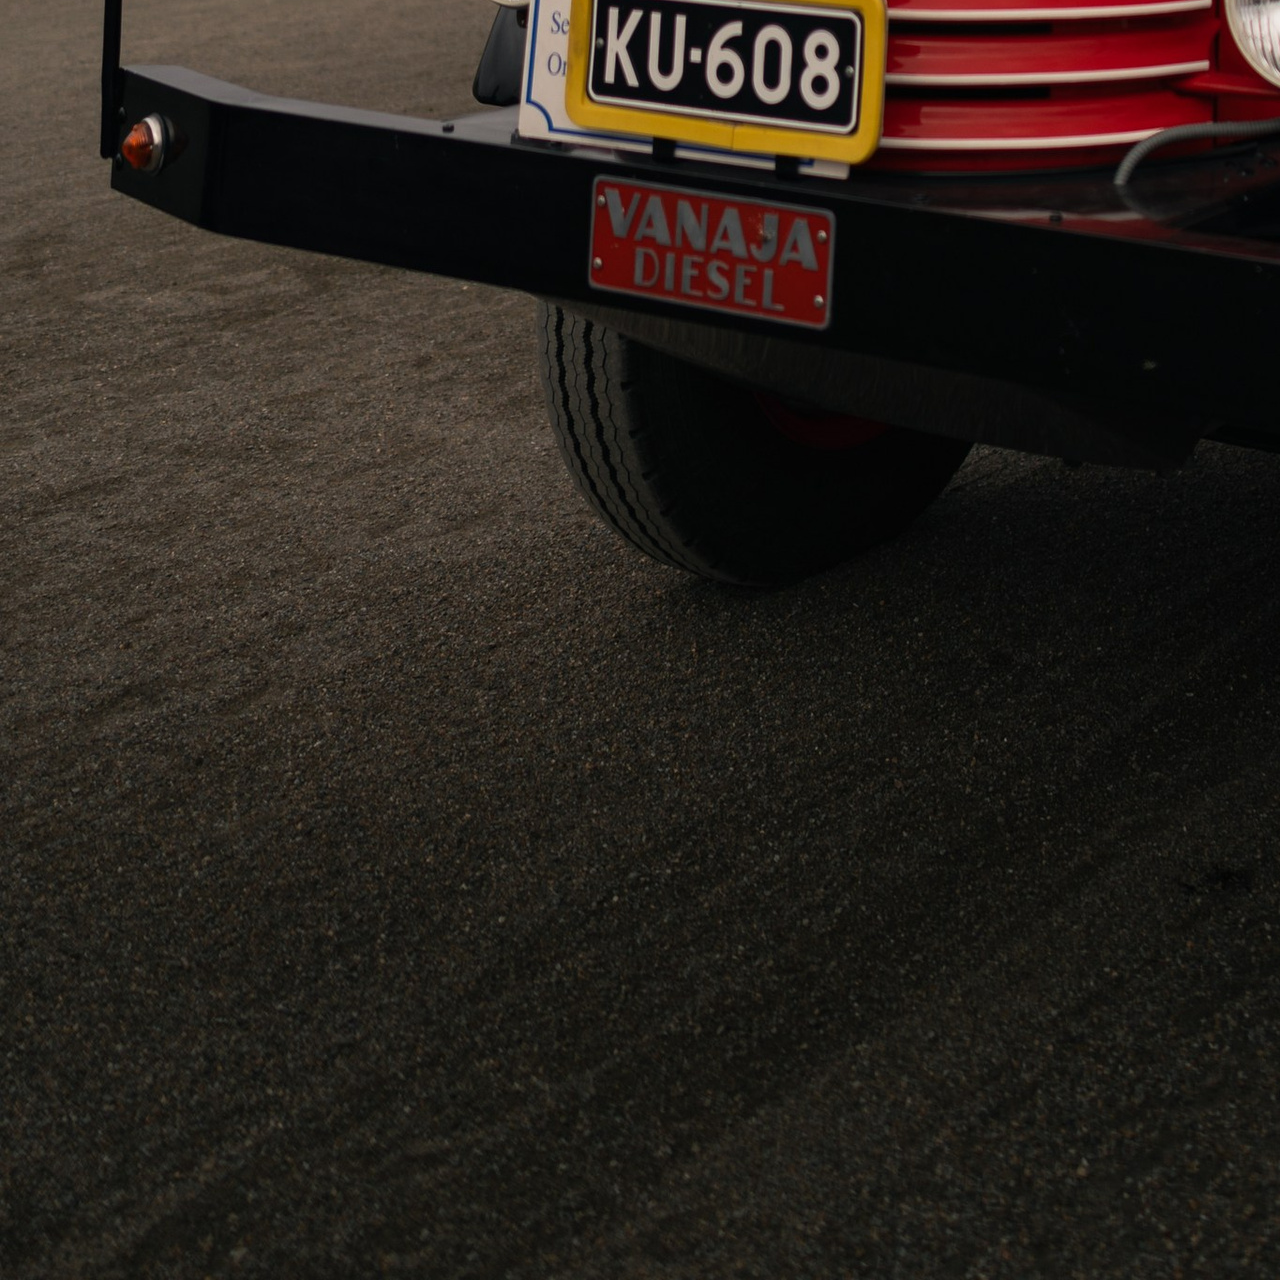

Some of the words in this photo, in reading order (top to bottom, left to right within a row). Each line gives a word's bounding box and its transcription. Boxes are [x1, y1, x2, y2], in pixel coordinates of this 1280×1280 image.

[603, 5, 841, 111] KU-608
[604, 187, 819, 272] VANAJA
[633, 246, 785, 312] DIESEL
